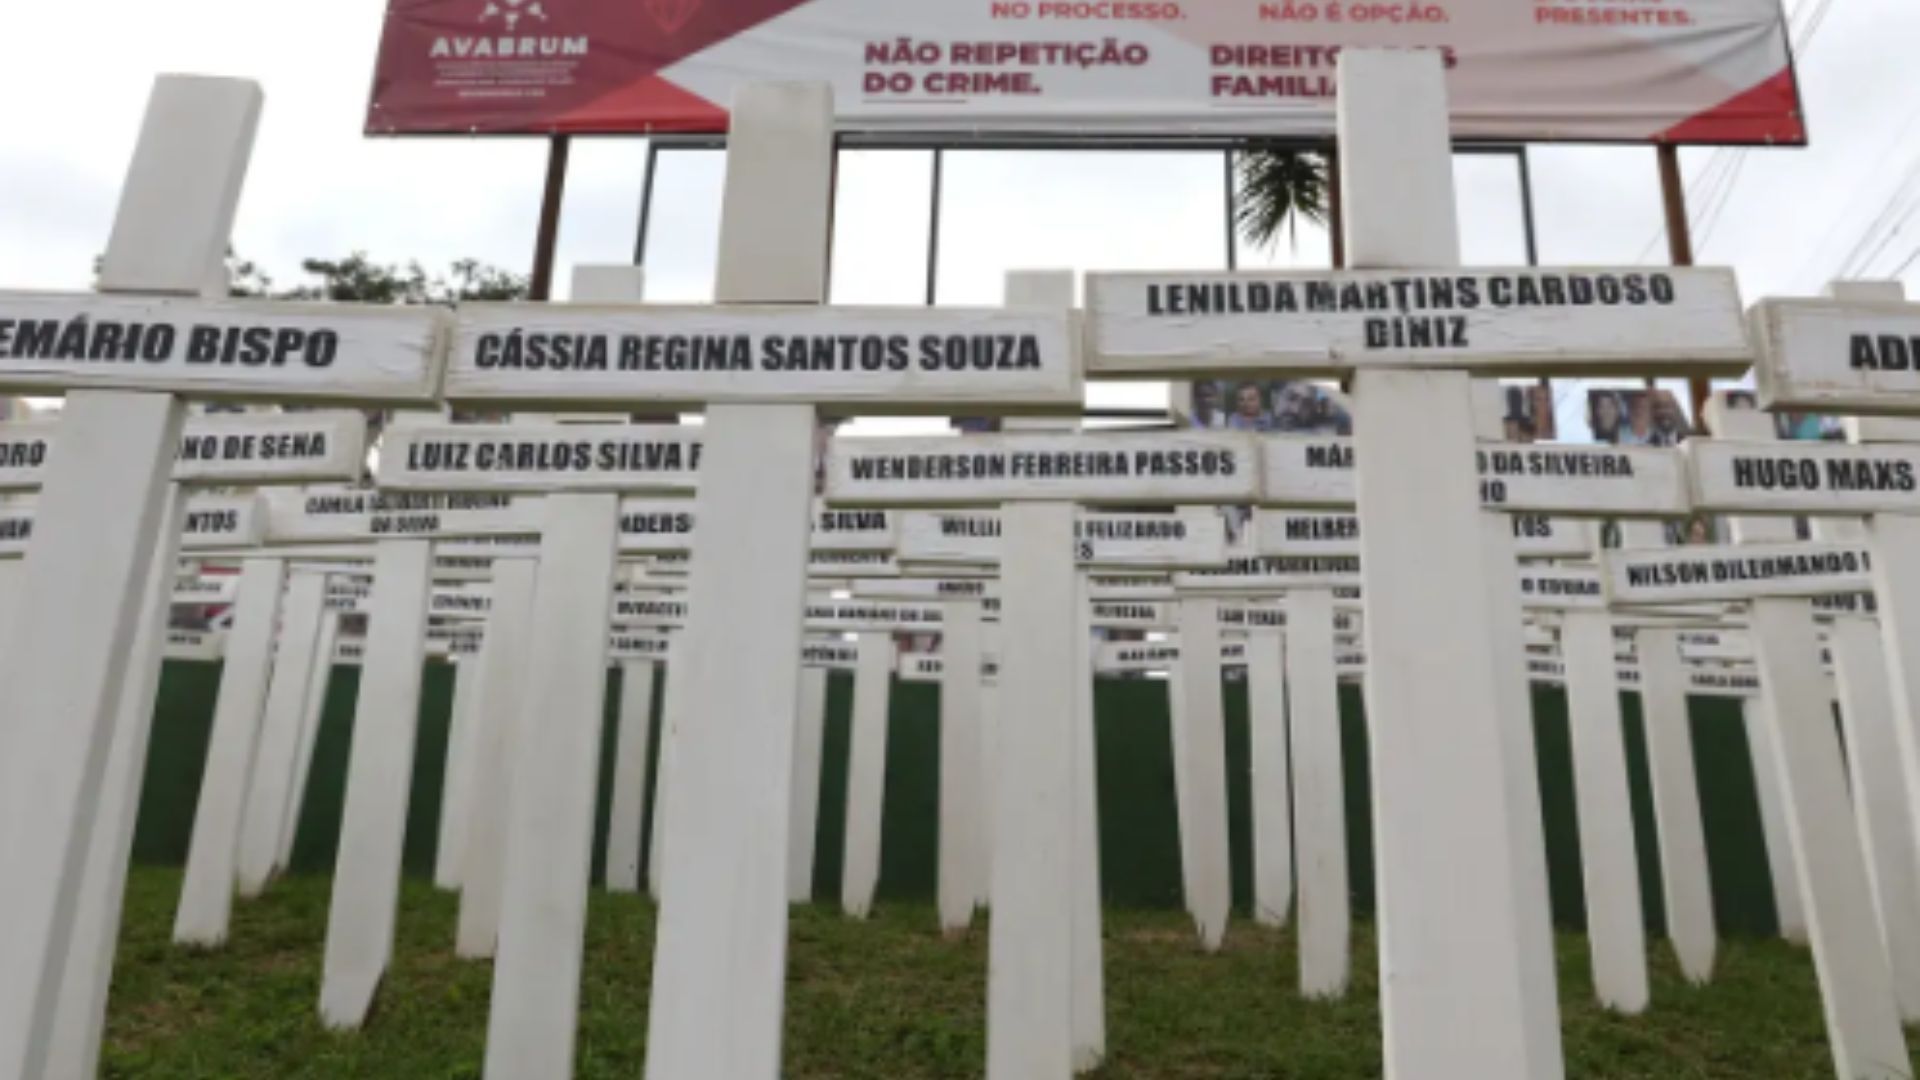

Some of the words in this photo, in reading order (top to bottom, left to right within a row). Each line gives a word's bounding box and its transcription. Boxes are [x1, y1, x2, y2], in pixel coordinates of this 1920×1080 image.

[990, 1, 1031, 20] NO
[1037, 1, 1187, 20] PROCESSO.
[1257, 2, 1320, 23] NÃO
[1324, 2, 1342, 22] É
[1349, 3, 1450, 24] OPÇÃO.
[1534, 6, 1696, 26] PRESENTES.
[429, 35, 589, 58] AVABRUM
[863, 36, 942, 67] NÃO
[948, 38, 1150, 70] REPETIÇÃO
[862, 71, 915, 95] DO
[922, 71, 1042, 96] CRIME.
[1211, 75, 1338, 98] FAMILI
[1147, 281, 1298, 316] LENILDA
[1304, 276, 1481, 314] MARTINS
[1487, 273, 1675, 308] CARDOSO
[185, 324, 339, 368] BISPO
[1363, 315, 1469, 349] DINIZ
[474, 327, 608, 371] CÁSSIA
[617, 335, 753, 371] REGINA
[760, 334, 910, 371] SANTOS
[918, 334, 1041, 371] SOUZA
[172, 434, 219, 462] NO
[222, 434, 257, 461] DE
[259, 430, 326, 461] SENA
[407, 442, 471, 471] LUIZ
[475, 441, 592, 471] CARLOS
[596, 441, 682, 471] SILVA
[850, 453, 1006, 480] WENDERSON
[1010, 451, 1129, 478] FERREIRA
[1134, 449, 1236, 476] PASSOS
[1491, 451, 1525, 475] DA
[1527, 451, 1634, 477] SILVEIRA
[1732, 457, 1821, 491] HUGO
[1825, 458, 1916, 492] MAXS
[820, 511, 888, 532] SILVA
